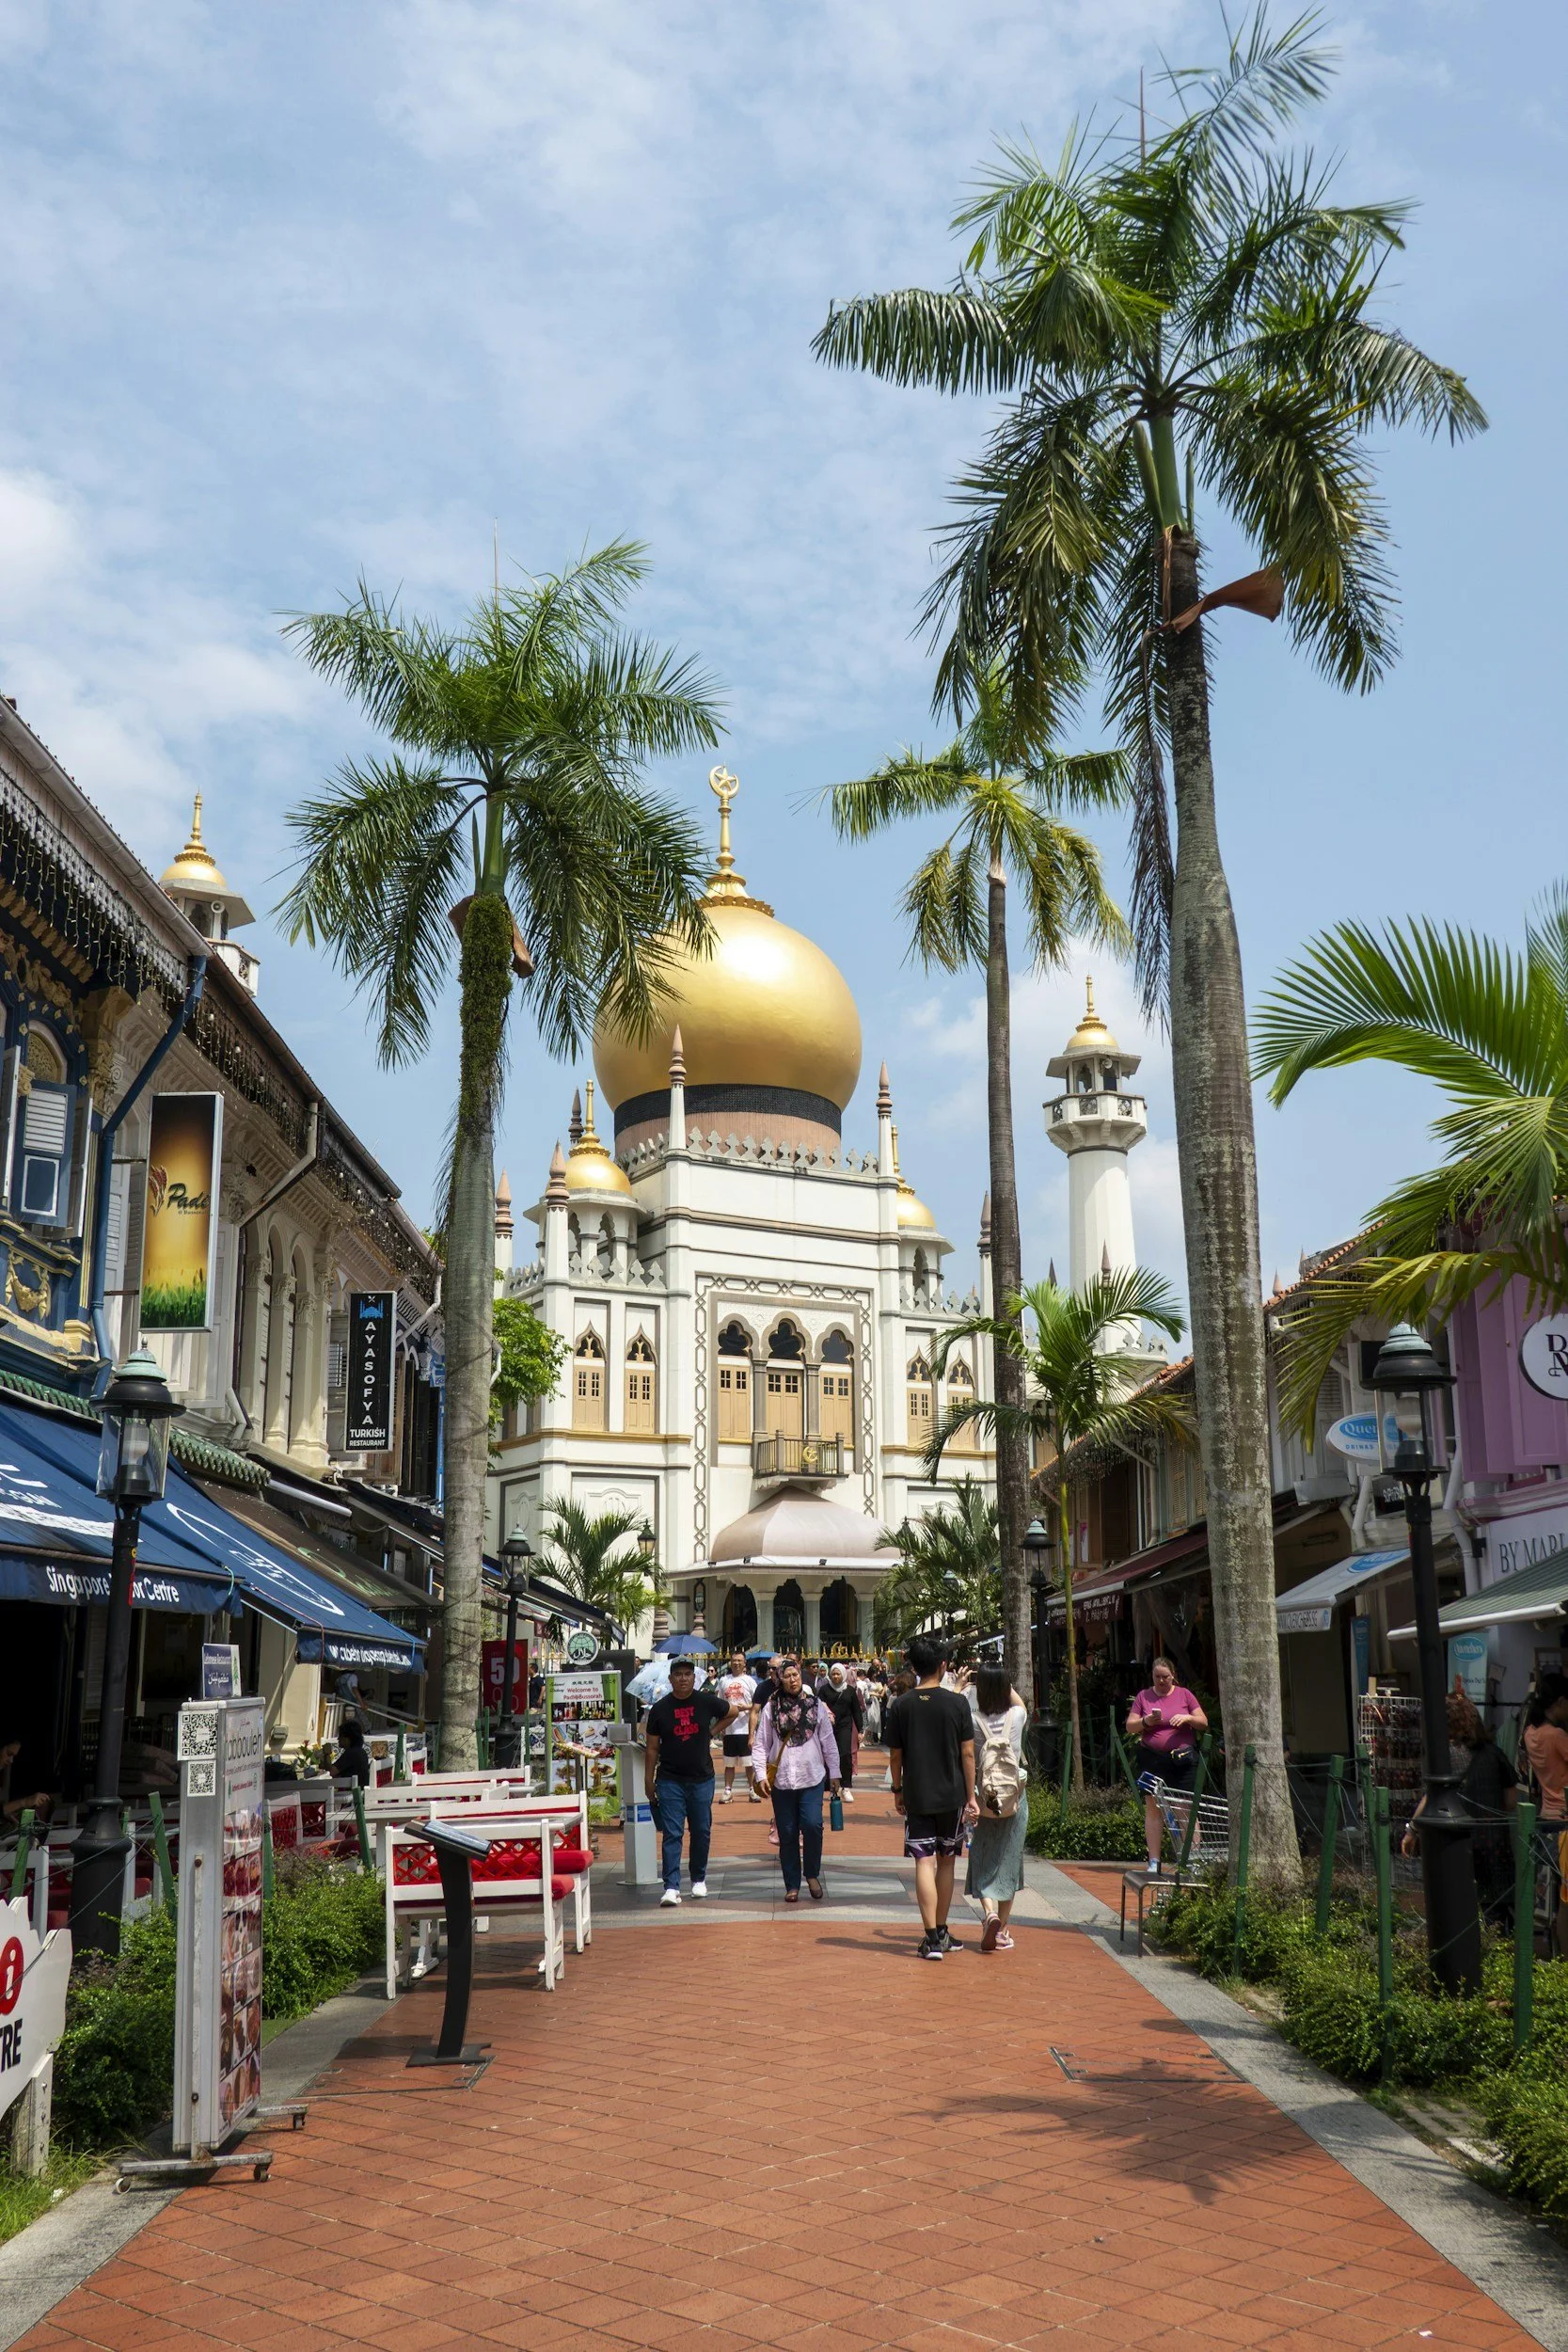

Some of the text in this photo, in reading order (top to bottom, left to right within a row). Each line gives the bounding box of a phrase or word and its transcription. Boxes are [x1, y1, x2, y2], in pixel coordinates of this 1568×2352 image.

[167, 1183, 210, 1209] Padi
[362, 1321, 376, 1425] AYASOFYA
[349, 1428, 386, 1438] TURKISH
[1498, 1541, 1519, 1573] BY
[46, 1565, 111, 1599] Singapore
[673, 1706, 694, 1719] BEST
[673, 1723, 700, 1736] CLASS
